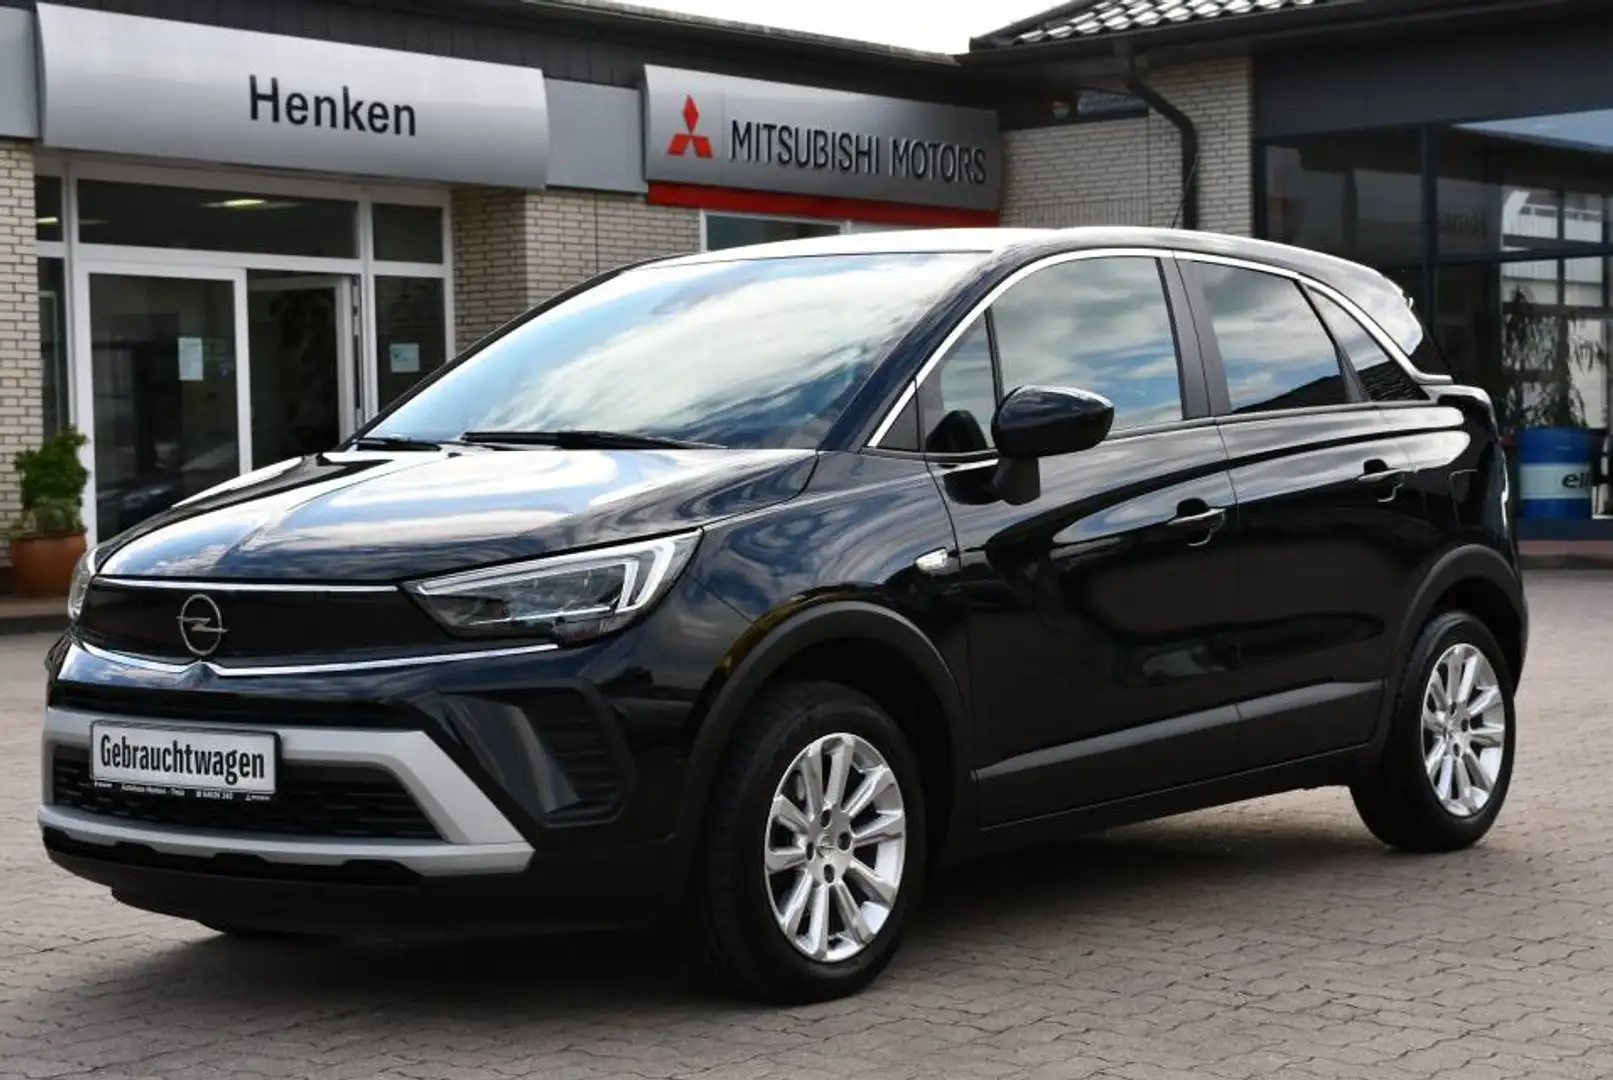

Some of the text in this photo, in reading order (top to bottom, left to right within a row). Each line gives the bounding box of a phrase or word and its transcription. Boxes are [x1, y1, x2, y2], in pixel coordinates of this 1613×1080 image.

[249, 74, 416, 136] Henken
[729, 119, 987, 185] MITSUBISHI MOTORS
[100, 733, 265, 786] Gebrauchtwagen
